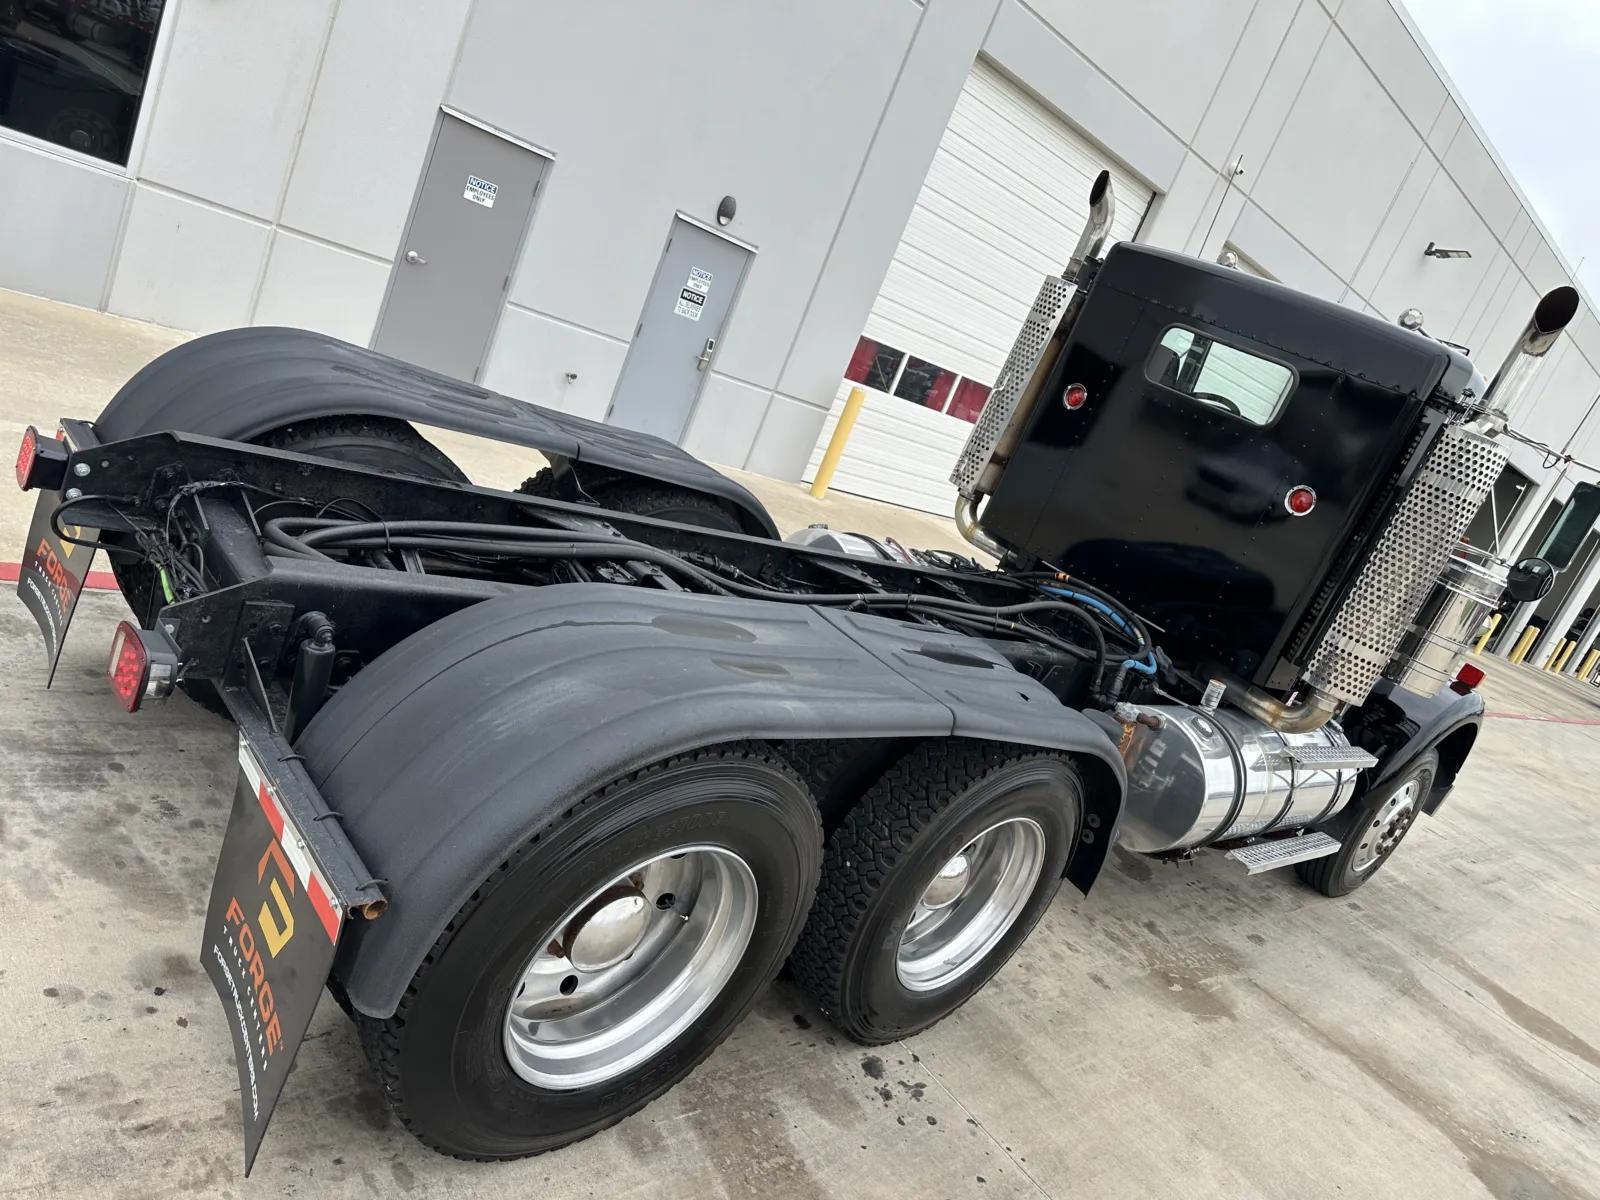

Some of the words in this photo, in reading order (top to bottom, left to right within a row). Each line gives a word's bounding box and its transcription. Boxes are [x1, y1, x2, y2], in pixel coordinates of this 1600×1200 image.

[467, 186, 495, 200] EMPLOYEES
[469, 177, 495, 194] NOTICE
[473, 195, 485, 203] ONLY
[682, 290, 703, 304] NOTICE
[37, 538, 71, 615] FORGE
[225, 896, 282, 1056] FORGE
[223, 925, 245, 979] TRUCK
[247, 985, 268, 1071] CENTERS
